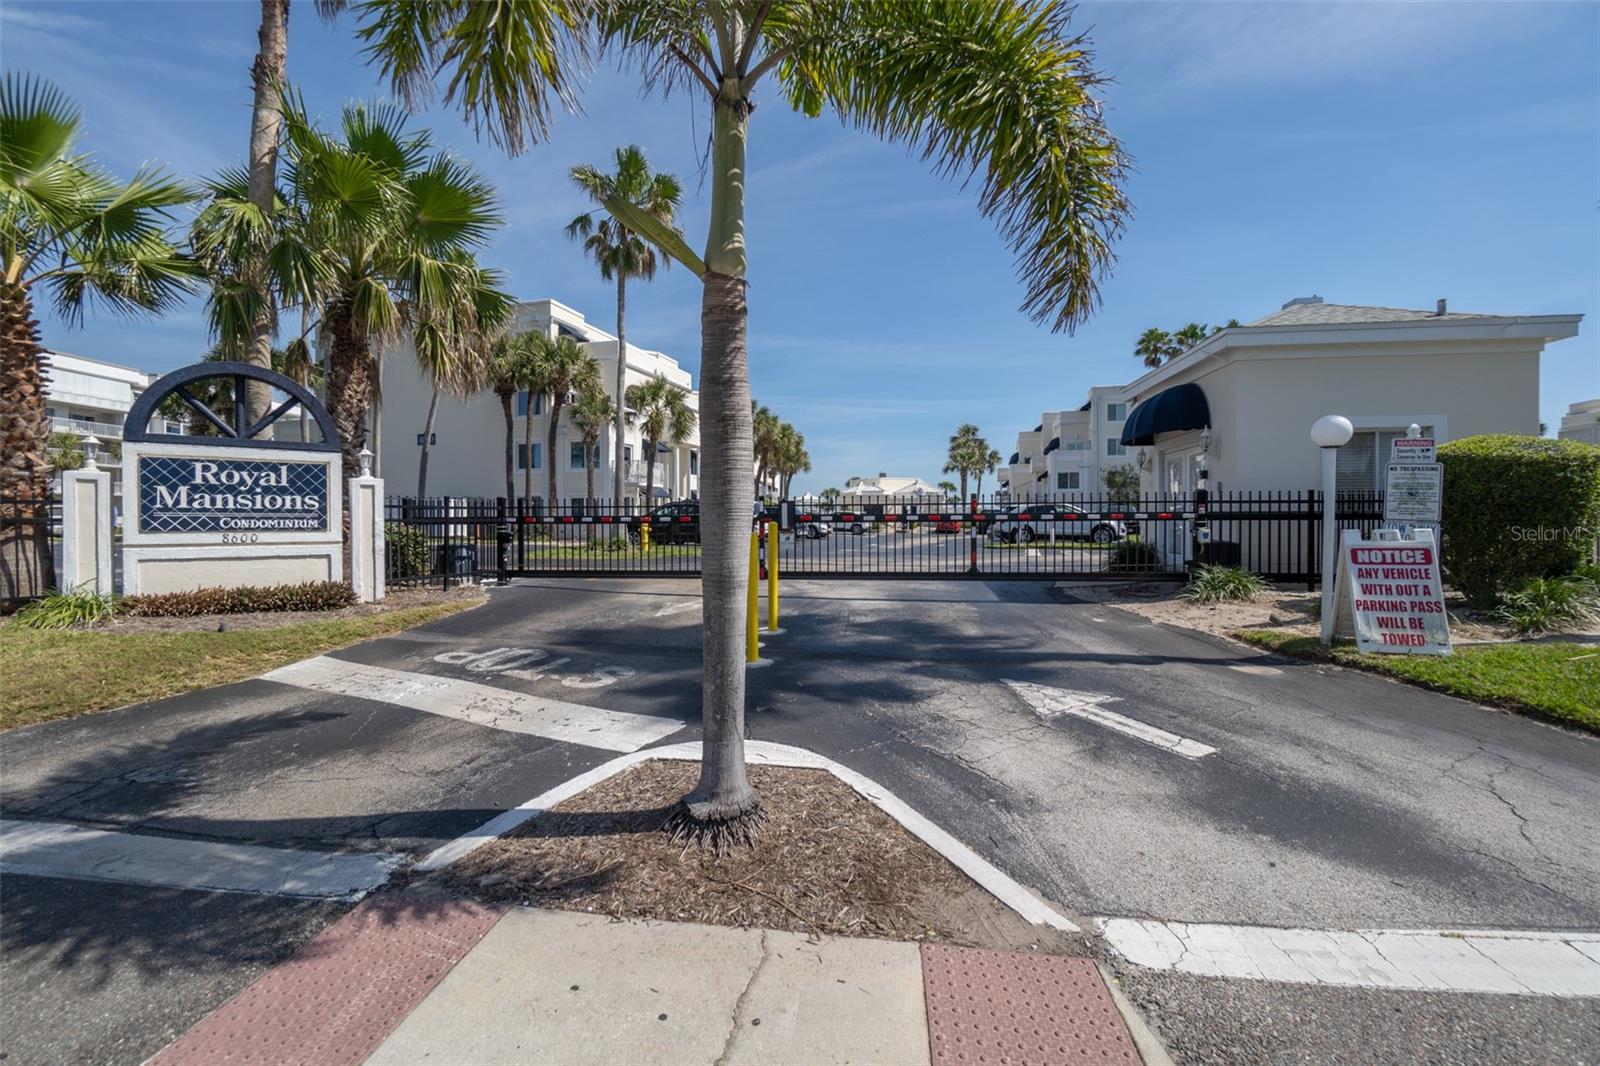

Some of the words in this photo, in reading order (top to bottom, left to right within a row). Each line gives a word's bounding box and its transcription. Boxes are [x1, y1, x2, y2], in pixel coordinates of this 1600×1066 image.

[192, 461, 289, 490] Royal
[153, 485, 320, 510] Mansions
[221, 533, 259, 544] 8600
[1356, 549, 1426, 563] NOTICE
[1357, 567, 1379, 579] ANY
[1381, 568, 1432, 580] VEHICLE
[1361, 583, 1394, 595] WITH
[1395, 584, 1420, 596] OUT
[1422, 585, 1432, 597] A
[1355, 599, 1408, 612] PARKING
[1410, 601, 1443, 613] PASS
[1376, 616, 1407, 629] WILL
[1409, 617, 1425, 629] BE
[1381, 633, 1426, 646] TOWED
[432, 647, 636, 689] STOP
